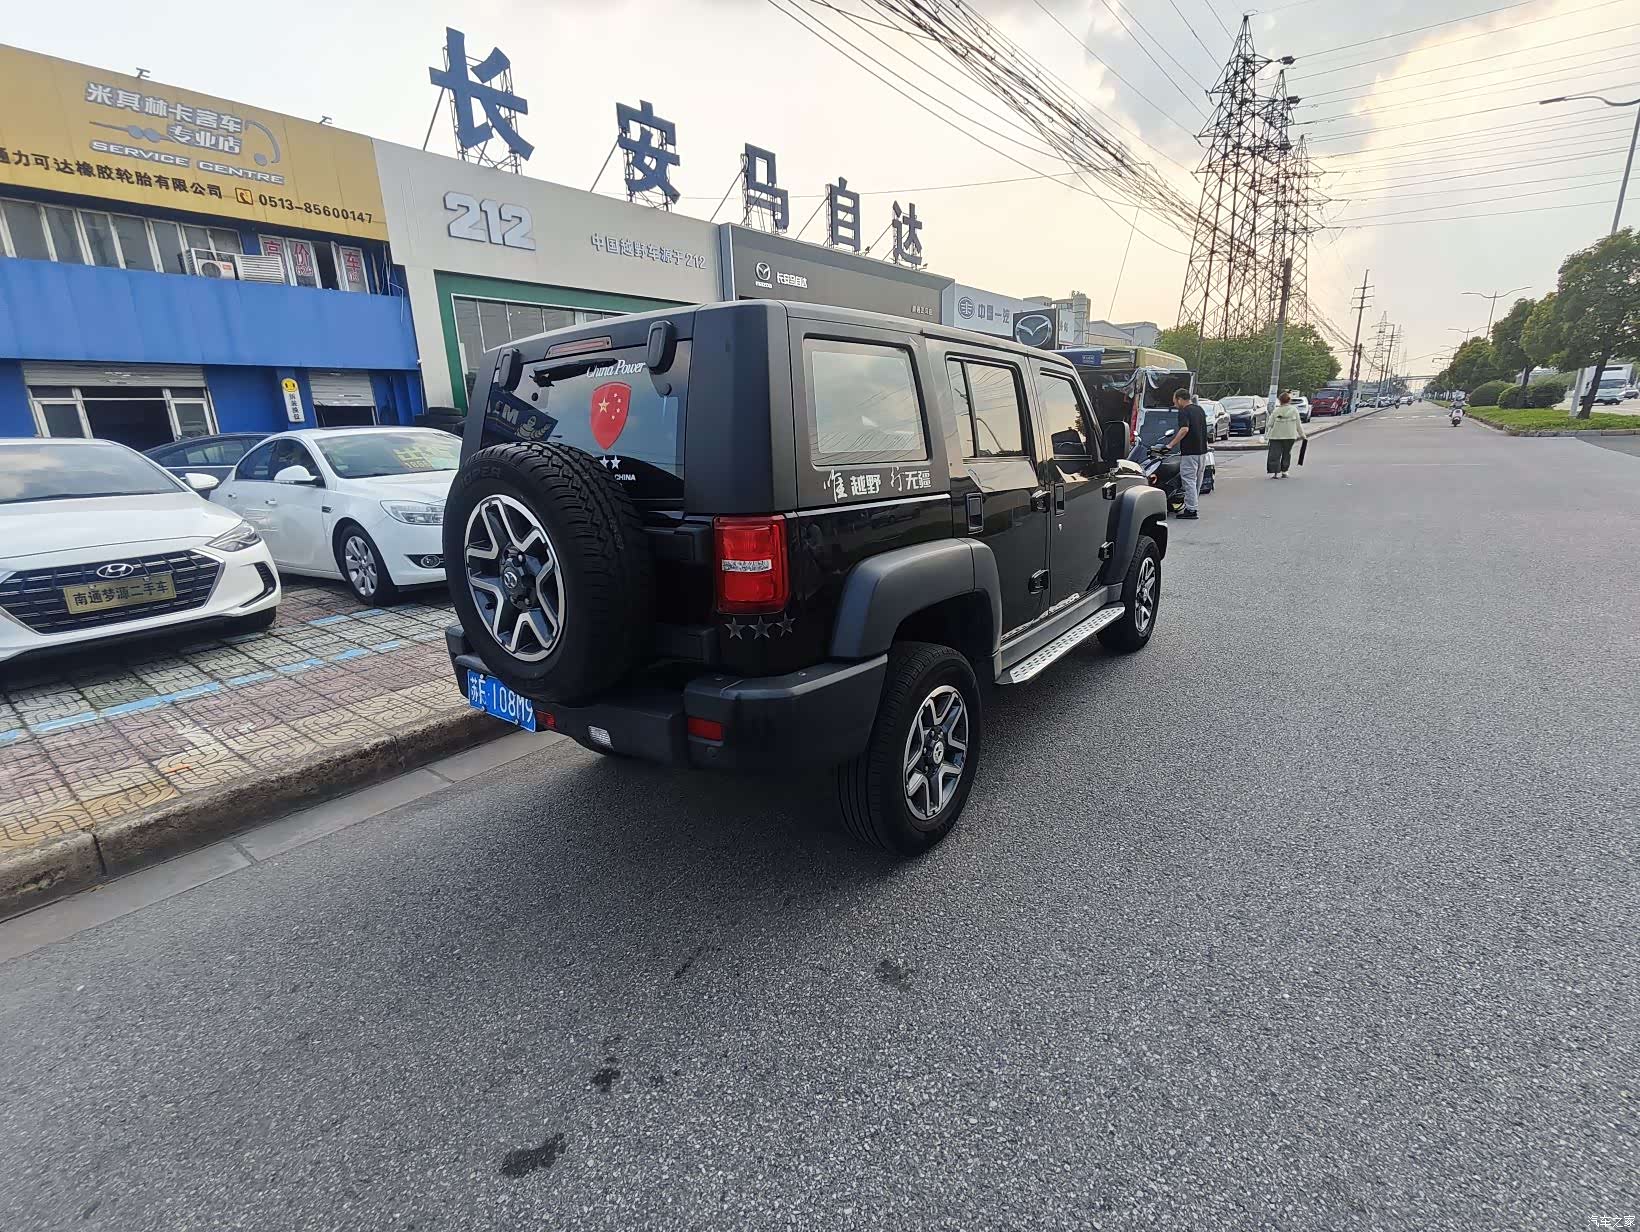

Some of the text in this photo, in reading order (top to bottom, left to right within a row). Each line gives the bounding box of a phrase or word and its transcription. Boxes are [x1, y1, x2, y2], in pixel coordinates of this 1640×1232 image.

[87, 82, 243, 133] 米其林卡客车
[168, 124, 242, 154] 专业店
[91, 141, 284, 183] SERVICE CENTRE
[258, 193, 374, 224] 0513-85600147
[443, 191, 536, 251] 212
[614, 359, 646, 375] Power
[72, 580, 170, 607] 南通梦源二手车
